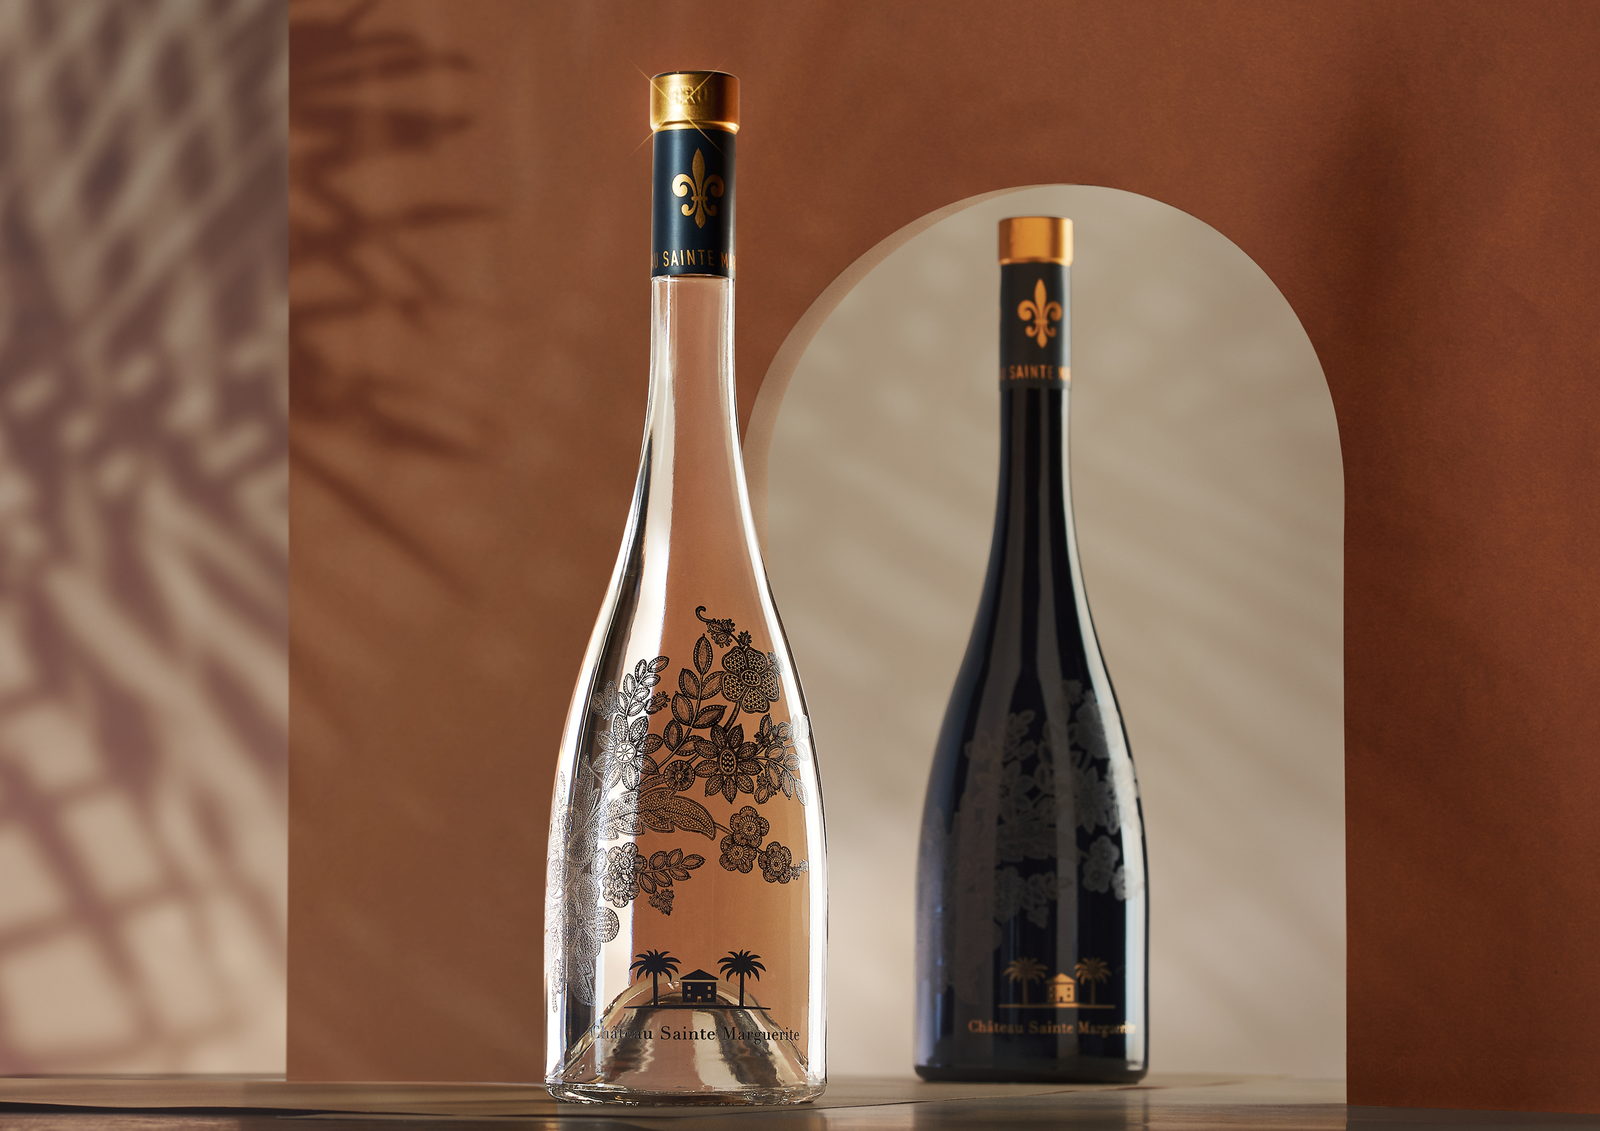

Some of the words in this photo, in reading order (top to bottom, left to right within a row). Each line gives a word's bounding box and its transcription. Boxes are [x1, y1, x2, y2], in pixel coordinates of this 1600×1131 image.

[662, 249, 715, 268] SAINTE
[1008, 364, 1054, 381] SAINTE
[590, 1025, 653, 1041] Château
[660, 1025, 716, 1041] Sainte
[722, 1026, 801, 1045] Marguerite
[1028, 1020, 1074, 1034] Sainte
